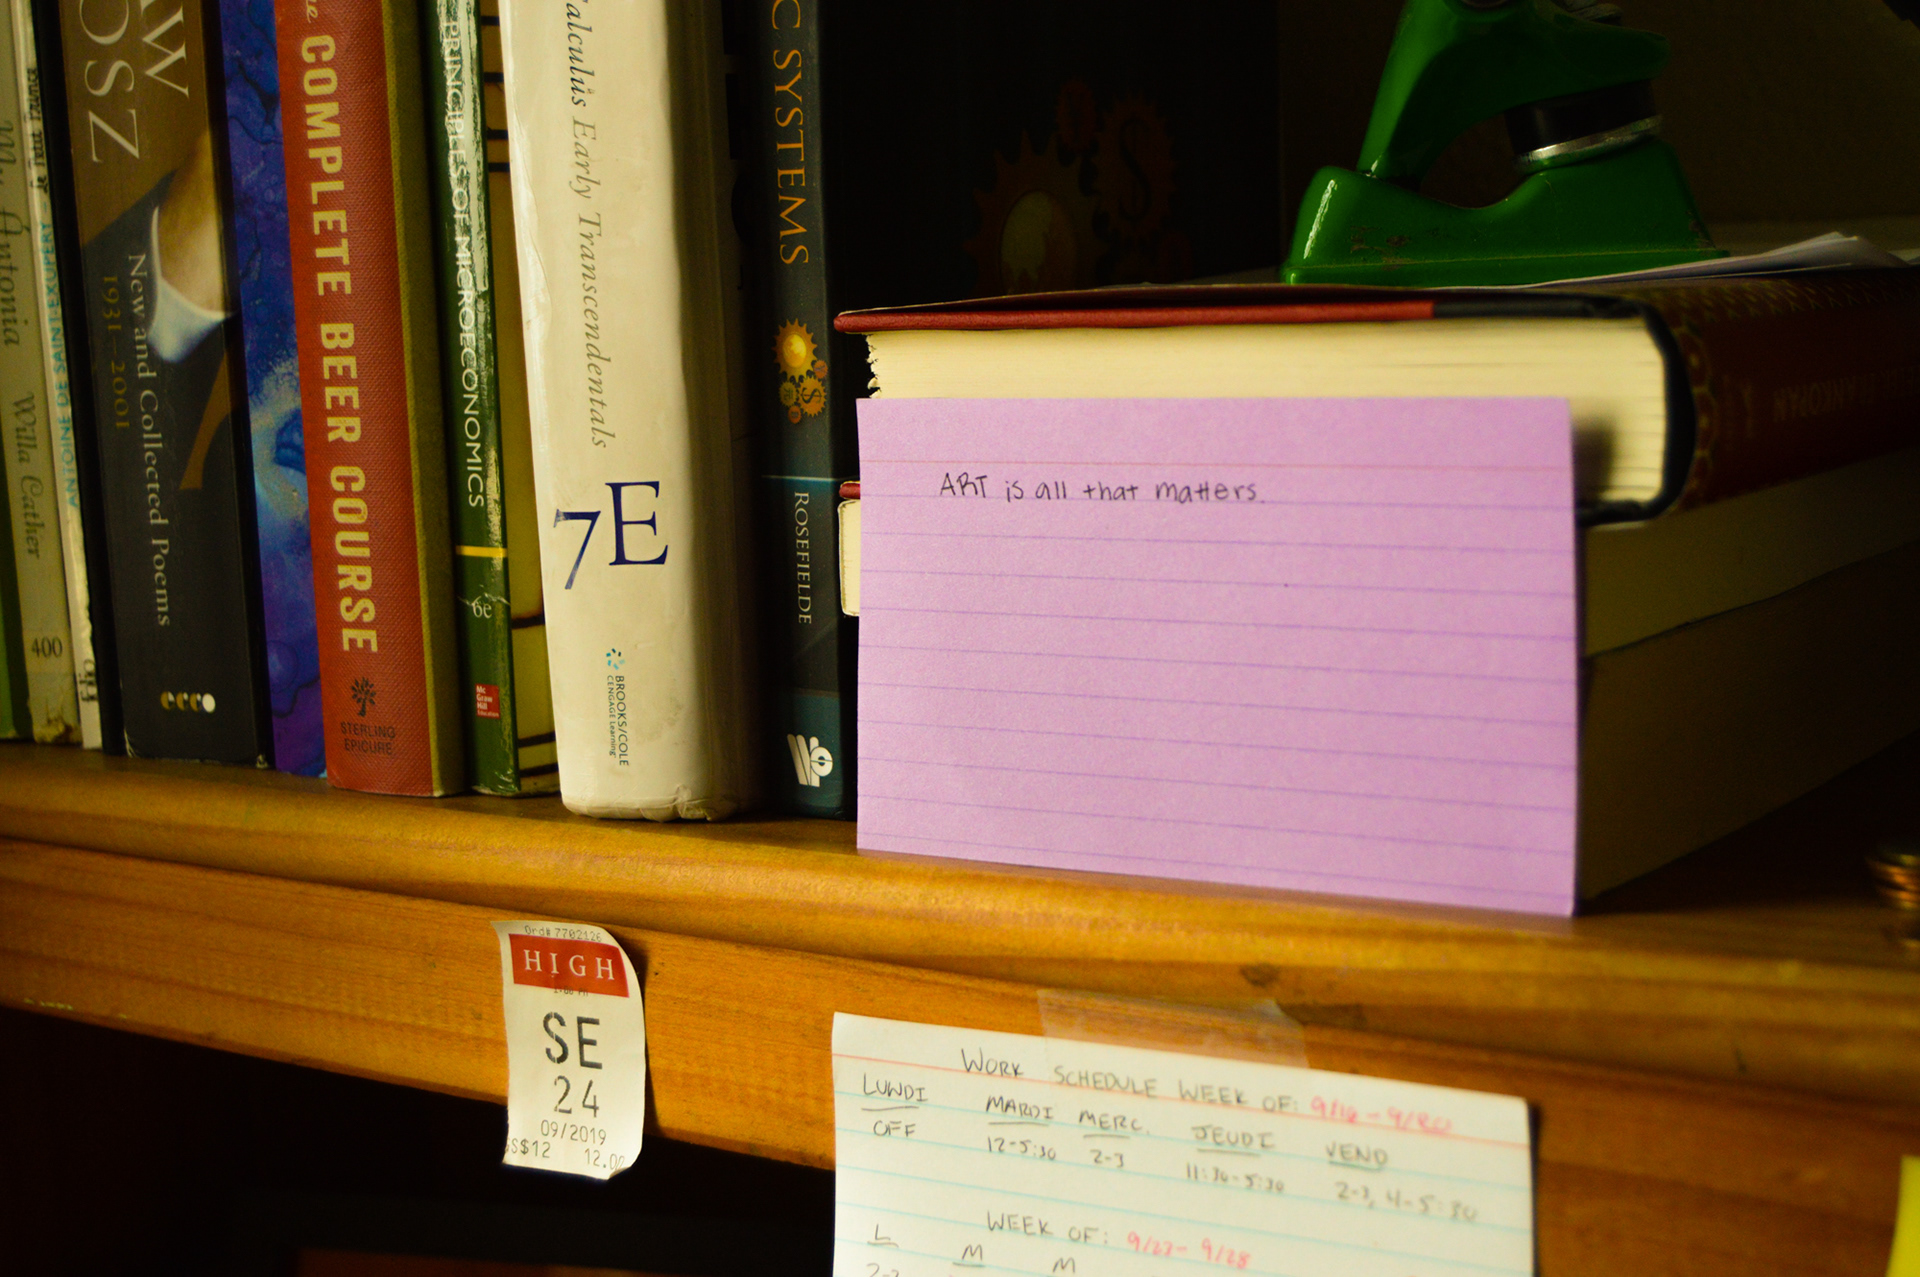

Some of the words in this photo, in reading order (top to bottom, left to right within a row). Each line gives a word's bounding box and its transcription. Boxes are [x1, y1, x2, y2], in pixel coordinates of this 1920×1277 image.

[141, 0, 190, 98] W
[564, 0, 596, 108] alculus
[441, 20, 468, 181] PRINCIPLES
[301, 34, 352, 297] COMPLETE
[568, 115, 602, 200] Early
[773, 48, 809, 265] SYSTEMS
[450, 188, 470, 227] OF
[127, 252, 147, 324] New
[134, 329, 158, 379] and
[577, 212, 616, 449] Transcendentals
[55, 381, 70, 407] DE
[319, 322, 362, 443] BEER
[455, 235, 484, 508] MICROECONOMICS
[12, 392, 39, 464] Willa
[139, 389, 170, 526] Collected
[58, 415, 79, 508] ANTOINE
[940, 471, 988, 499] ART
[1005, 480, 1025, 503] is
[1035, 480, 1067, 501] all
[1082, 480, 1139, 501] that
[20, 474, 44, 560] Cather
[553, 480, 669, 591] 7E
[151, 537, 171, 627] Poems
[329, 465, 379, 654] COURSE
[793, 491, 812, 625] ROSEFIELDE
[472, 595, 493, 619] 6e
[31, 636, 63, 659] 400
[476, 684, 487, 695] Mc
[476, 693, 494, 704] Graw
[476, 701, 488, 711] Hill
[606, 674, 617, 719] CENGAGE
[340, 720, 396, 739] STERLING
[344, 738, 393, 755] EPICURE
[608, 720, 618, 758] Learning
[614, 674, 630, 766] BROOKS/COLE
[524, 924, 551, 938] Ord#
[554, 926, 603, 943] 7702126
[523, 949, 615, 980] HIGH
[543, 1011, 603, 1070] SE
[553, 1075, 600, 1119] 24
[961, 1046, 1024, 1077] WORK
[1053, 1065, 1158, 1099] SCHEDULE
[1178, 1079, 1248, 1105] WEEK
[540, 1119, 607, 1146] 09/2019
[862, 1072, 929, 1103] LUNDI
[985, 1095, 1054, 1120] MARDI
[1191, 1123, 1276, 1150] JEUDI
[1325, 1140, 1389, 1167] VEND
[872, 1119, 917, 1138] OFF
[987, 1135, 1057, 1162] 12-5:30
[1090, 1148, 1125, 1168] 2-3
[874, 1222, 892, 1241] L
[961, 1243, 983, 1262] M
[1053, 1256, 1077, 1274] M
[986, 1209, 1054, 1236] WEEK
